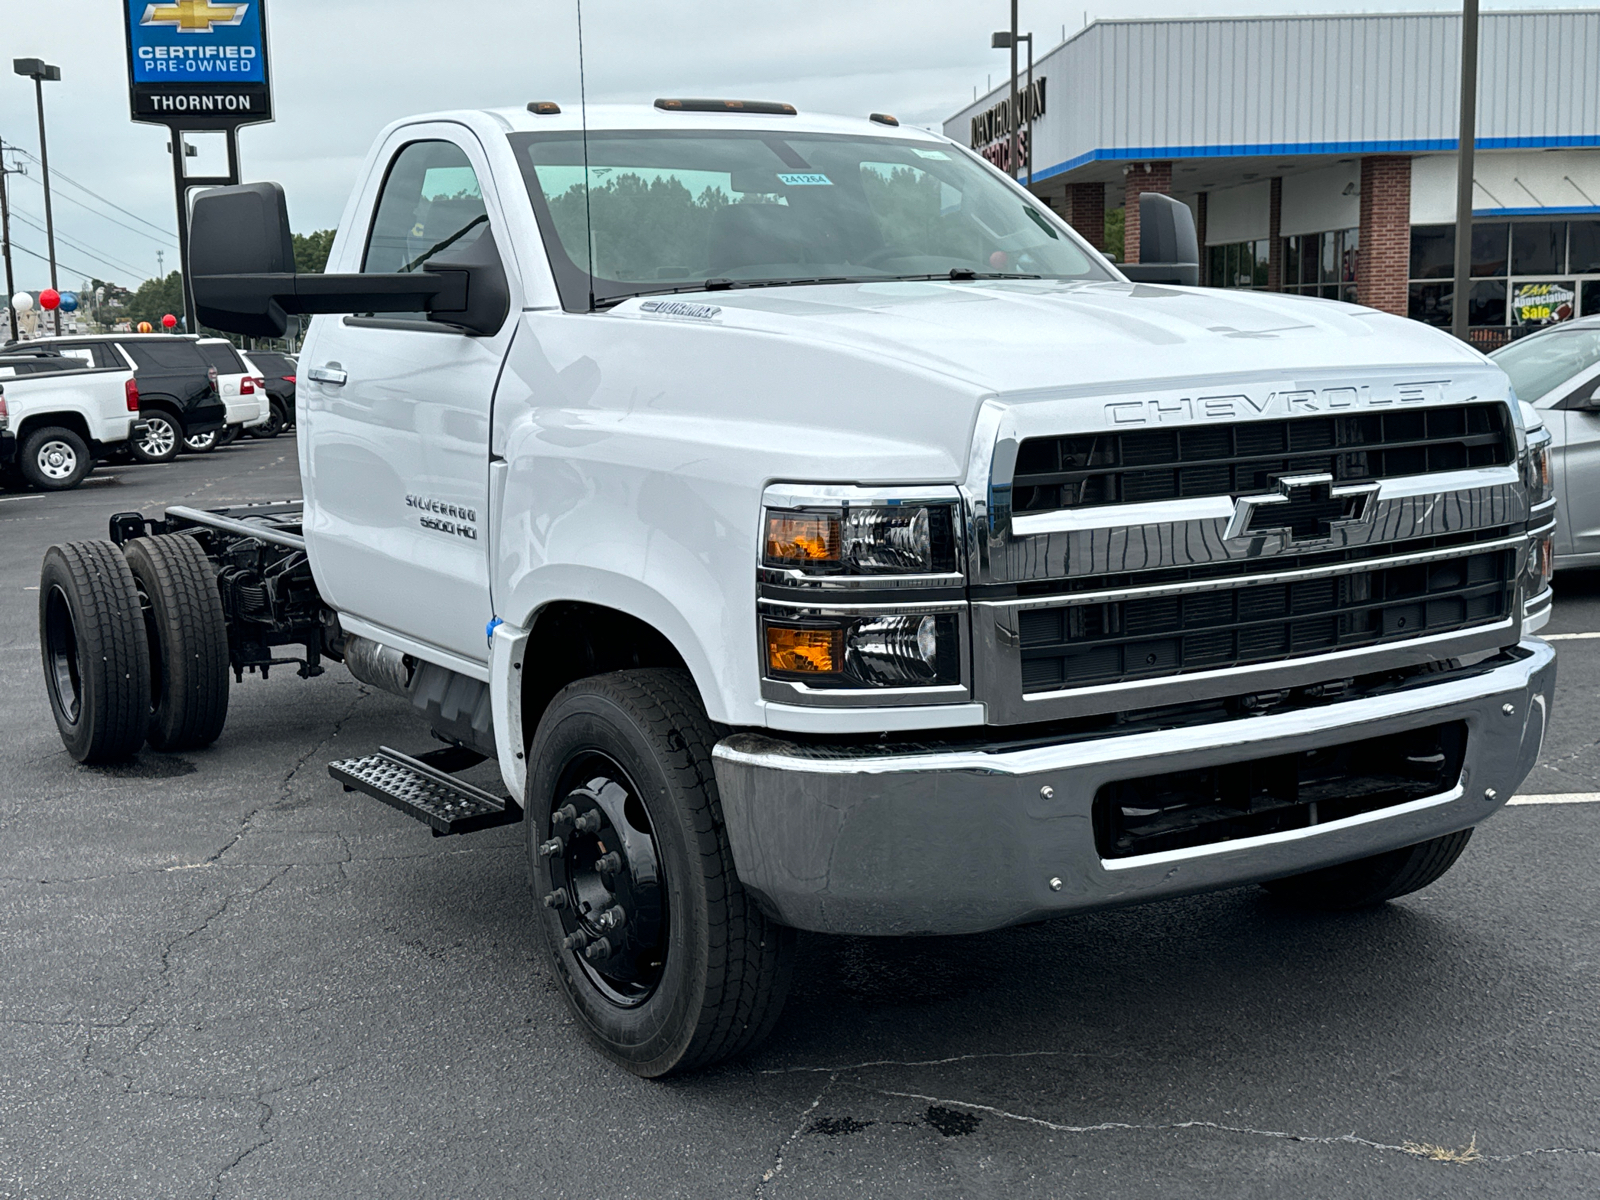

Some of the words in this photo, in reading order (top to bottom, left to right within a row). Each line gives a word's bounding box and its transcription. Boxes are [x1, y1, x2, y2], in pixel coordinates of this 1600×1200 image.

[138, 46, 256, 59] CERTIFIED
[145, 60, 251, 72] PRE-OWNED
[151, 95, 251, 110] THORNTON
[781, 175, 827, 183] 241264
[1520, 284, 1552, 295] FAN
[1514, 292, 1573, 308] Appreciation
[1522, 306, 1550, 319] Sale
[1104, 380, 1452, 426] CHEVROLET
[405, 495, 476, 522] SILVERADO
[420, 516, 455, 535] 5500
[456, 523, 477, 540] HD
